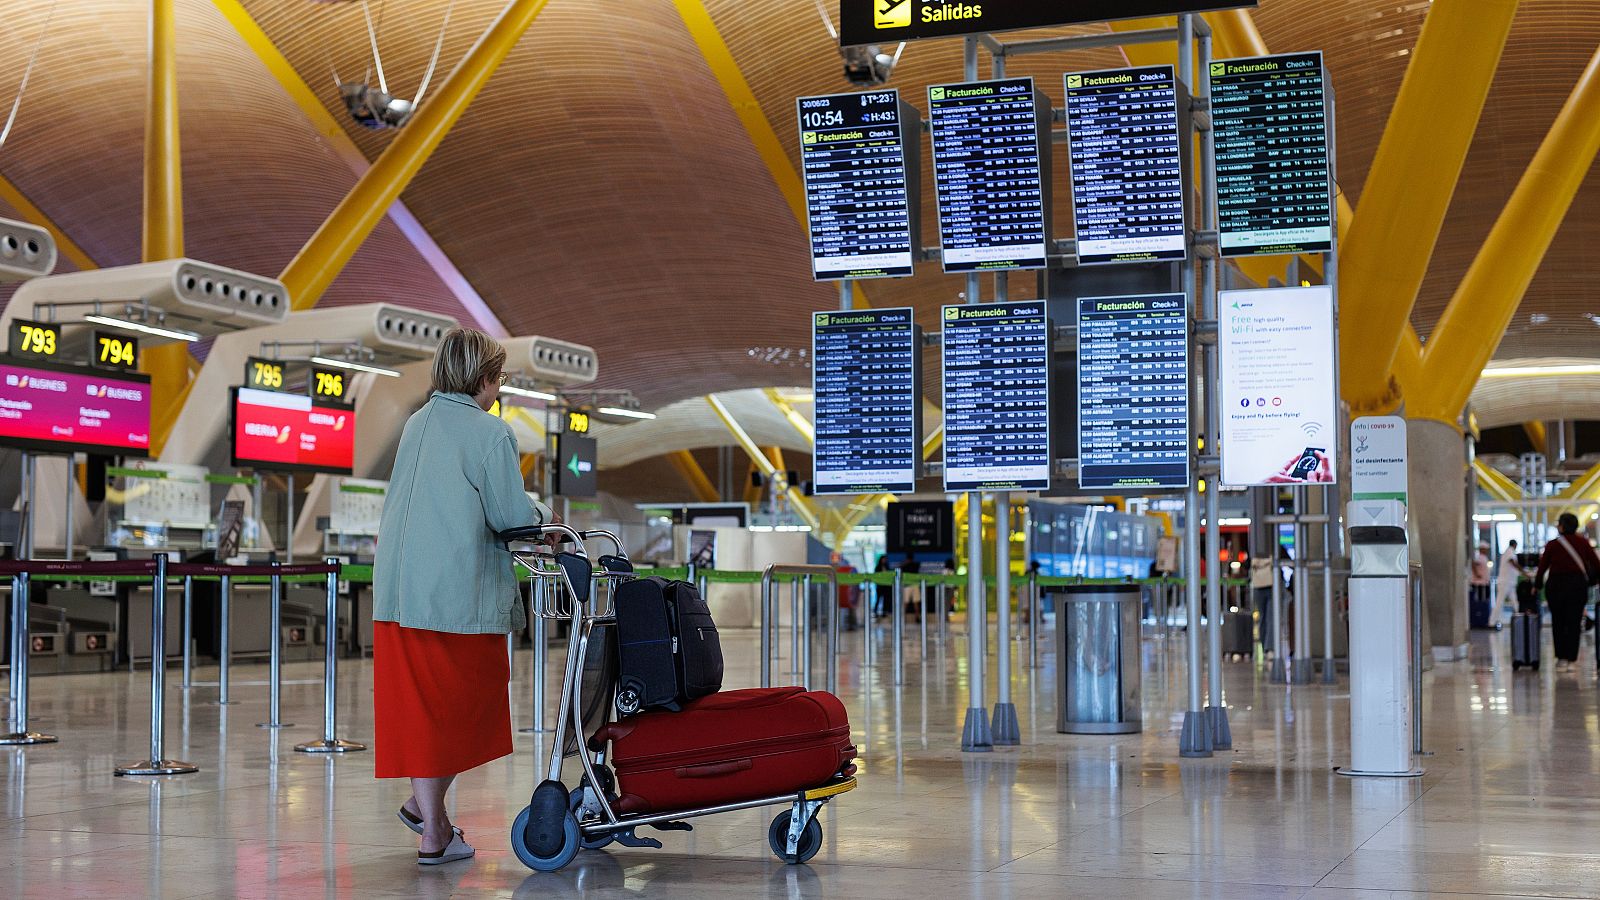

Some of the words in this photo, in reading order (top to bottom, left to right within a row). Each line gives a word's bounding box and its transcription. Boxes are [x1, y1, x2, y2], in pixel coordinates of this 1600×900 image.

[921, 2, 982, 23] Salidas
[1228, 61, 1277, 73] Facturación
[1286, 59, 1313, 68] Check-in
[1083, 74, 1132, 85] Facturación
[1139, 72, 1165, 80] Check-in
[946, 86, 992, 97] Facturación
[999, 84, 1025, 92] Check-in
[803, 110, 844, 128] 10:54
[818, 130, 862, 141] Facturación
[868, 129, 893, 137] Check-in
[961, 308, 1006, 317] Facturación
[1097, 300, 1144, 310] Facturación
[1152, 300, 1177, 308] Check-in
[831, 314, 874, 324] Facturación
[1232, 315, 1252, 324] Free
[20, 326, 56, 354] 793
[100, 338, 134, 366] 794
[6, 374, 18, 386] IB
[28, 376, 68, 392] BUSINESS
[254, 362, 282, 388] 795
[316, 372, 342, 396] 796
[86, 384, 98, 396] IB
[107, 386, 142, 402] BUSINESS
[308, 413, 336, 426] IBERIA
[570, 412, 588, 432] 799
[244, 422, 278, 438] IBERIA
